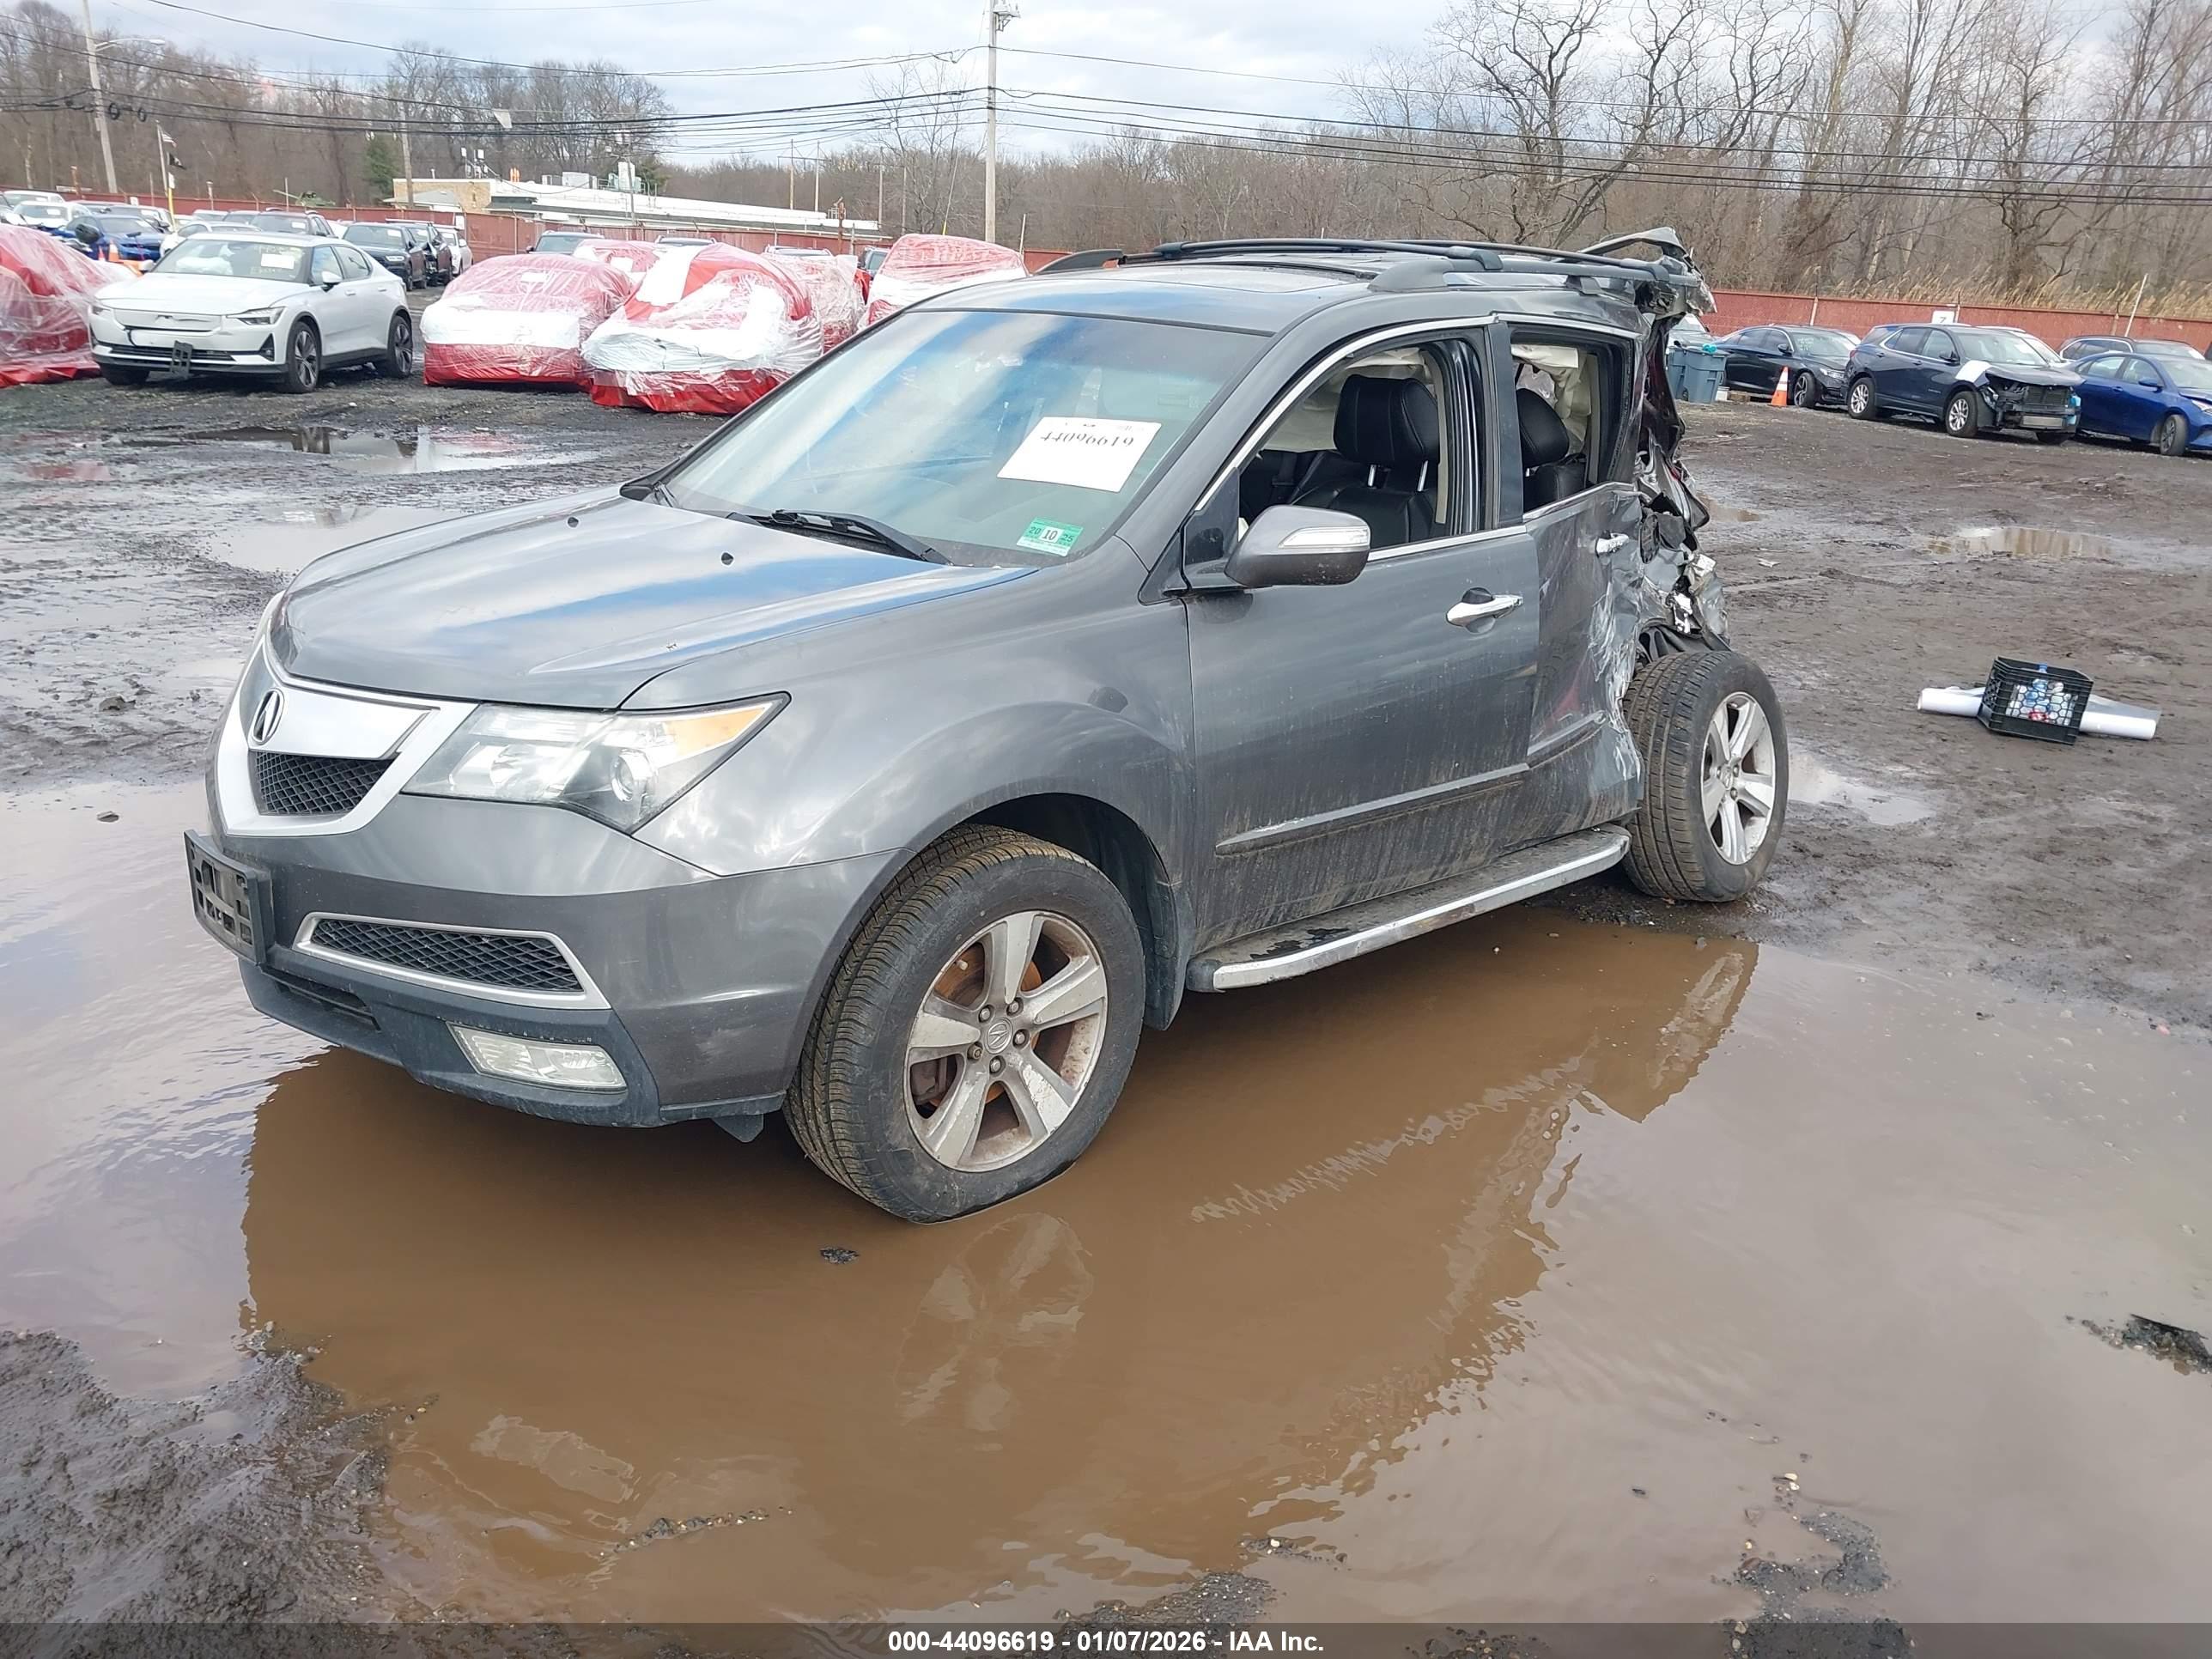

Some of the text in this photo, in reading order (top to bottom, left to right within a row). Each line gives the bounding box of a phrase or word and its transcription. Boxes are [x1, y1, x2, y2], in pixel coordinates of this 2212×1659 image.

[1029, 526, 1075, 543] 20 10 25
